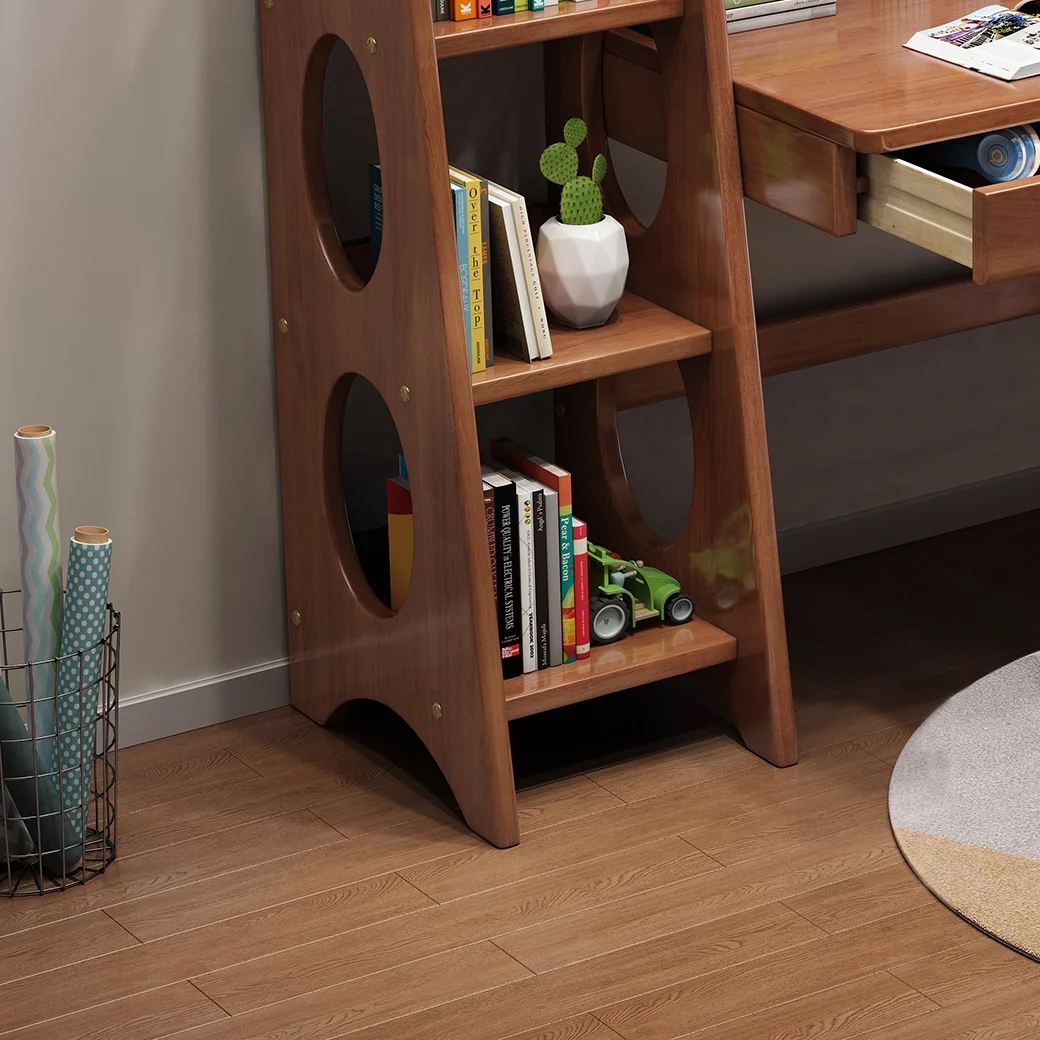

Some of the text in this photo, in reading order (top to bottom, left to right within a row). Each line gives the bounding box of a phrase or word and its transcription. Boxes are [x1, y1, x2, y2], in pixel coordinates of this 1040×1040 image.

[469, 187, 481, 328] Over the Top
[523, 229, 535, 278] PERCENTAGE
[502, 505, 510, 526] POWER
[501, 527, 512, 555] QUALITY
[561, 518, 571, 581] Pear & Bacon
[504, 562, 513, 600] ELECTRICAL
[505, 601, 514, 629] SYSTEMS
